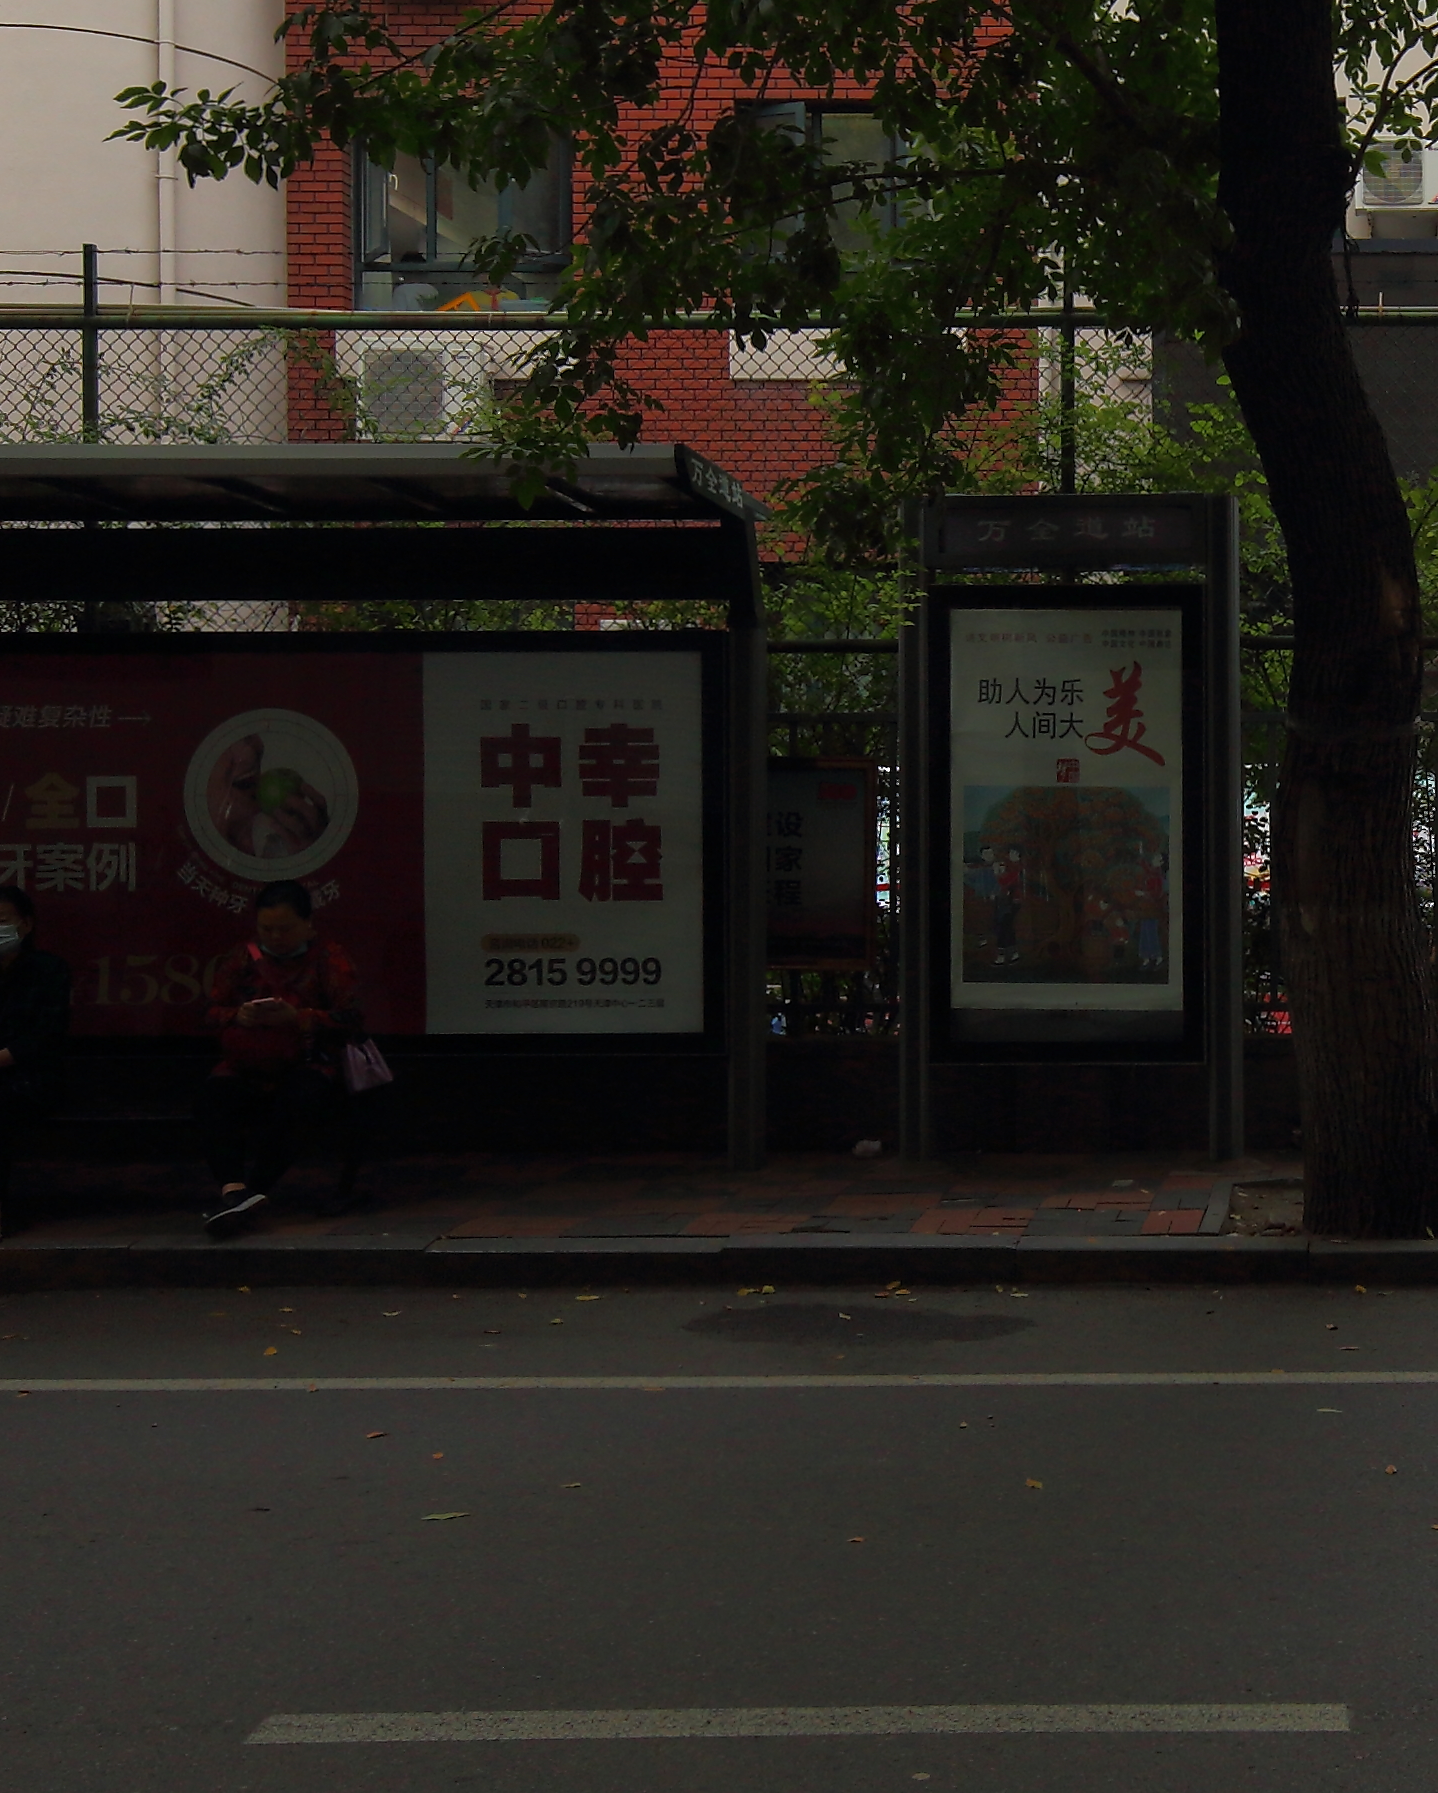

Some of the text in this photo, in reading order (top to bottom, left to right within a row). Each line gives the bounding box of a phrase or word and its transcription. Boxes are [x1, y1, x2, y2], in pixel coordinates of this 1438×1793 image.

[691, 457, 744, 508] 万全道站
[977, 515, 1156, 542] 万全道站
[977, 677, 1084, 706] 助人为乐
[1004, 711, 1084, 739] 人间大
[1084, 660, 1166, 767] 美
[481, 818, 663, 902] 口腔
[767, 846, 803, 873] 家
[484, 957, 662, 987] 2815 9999
